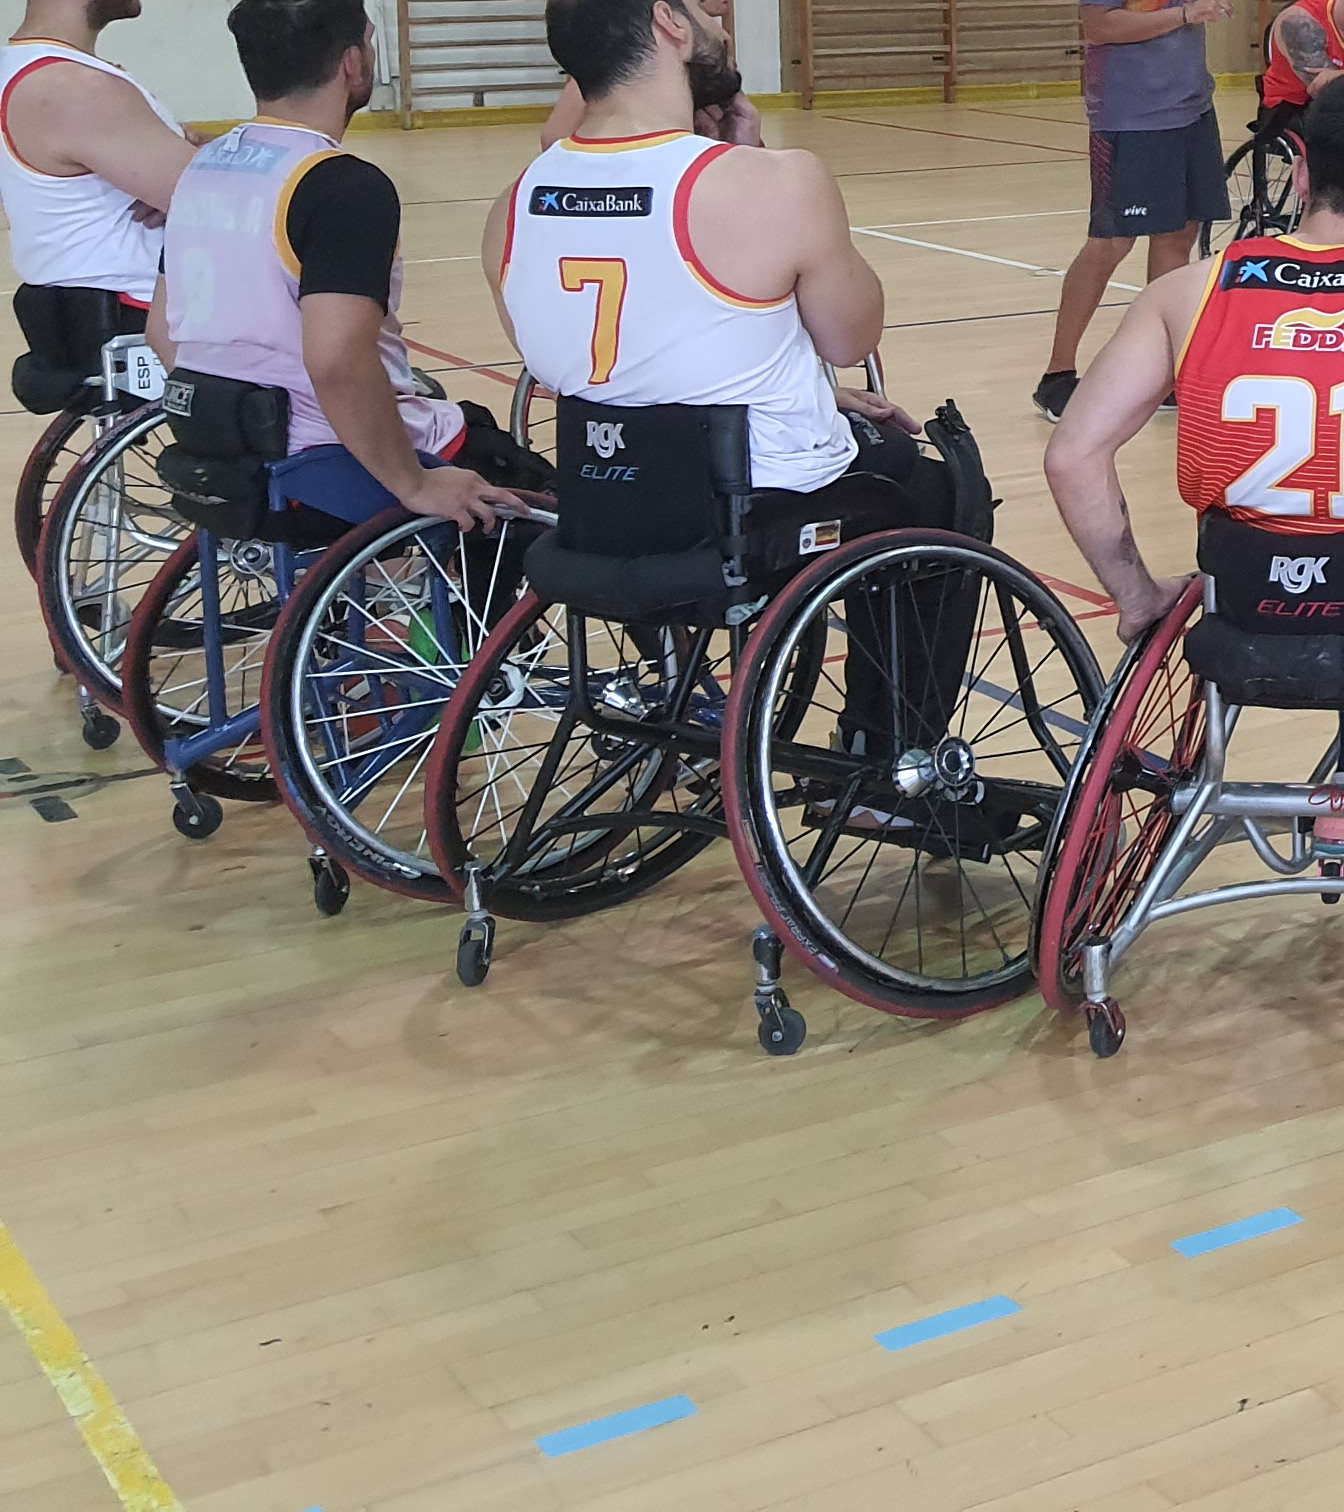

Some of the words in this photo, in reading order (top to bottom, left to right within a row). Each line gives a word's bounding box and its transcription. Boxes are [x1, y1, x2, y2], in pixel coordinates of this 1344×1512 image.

[562, 192, 643, 212] CaixaBank
[559, 256, 627, 385] 7
[138, 355, 151, 390] ESP
[579, 464, 639, 481] ELITE
